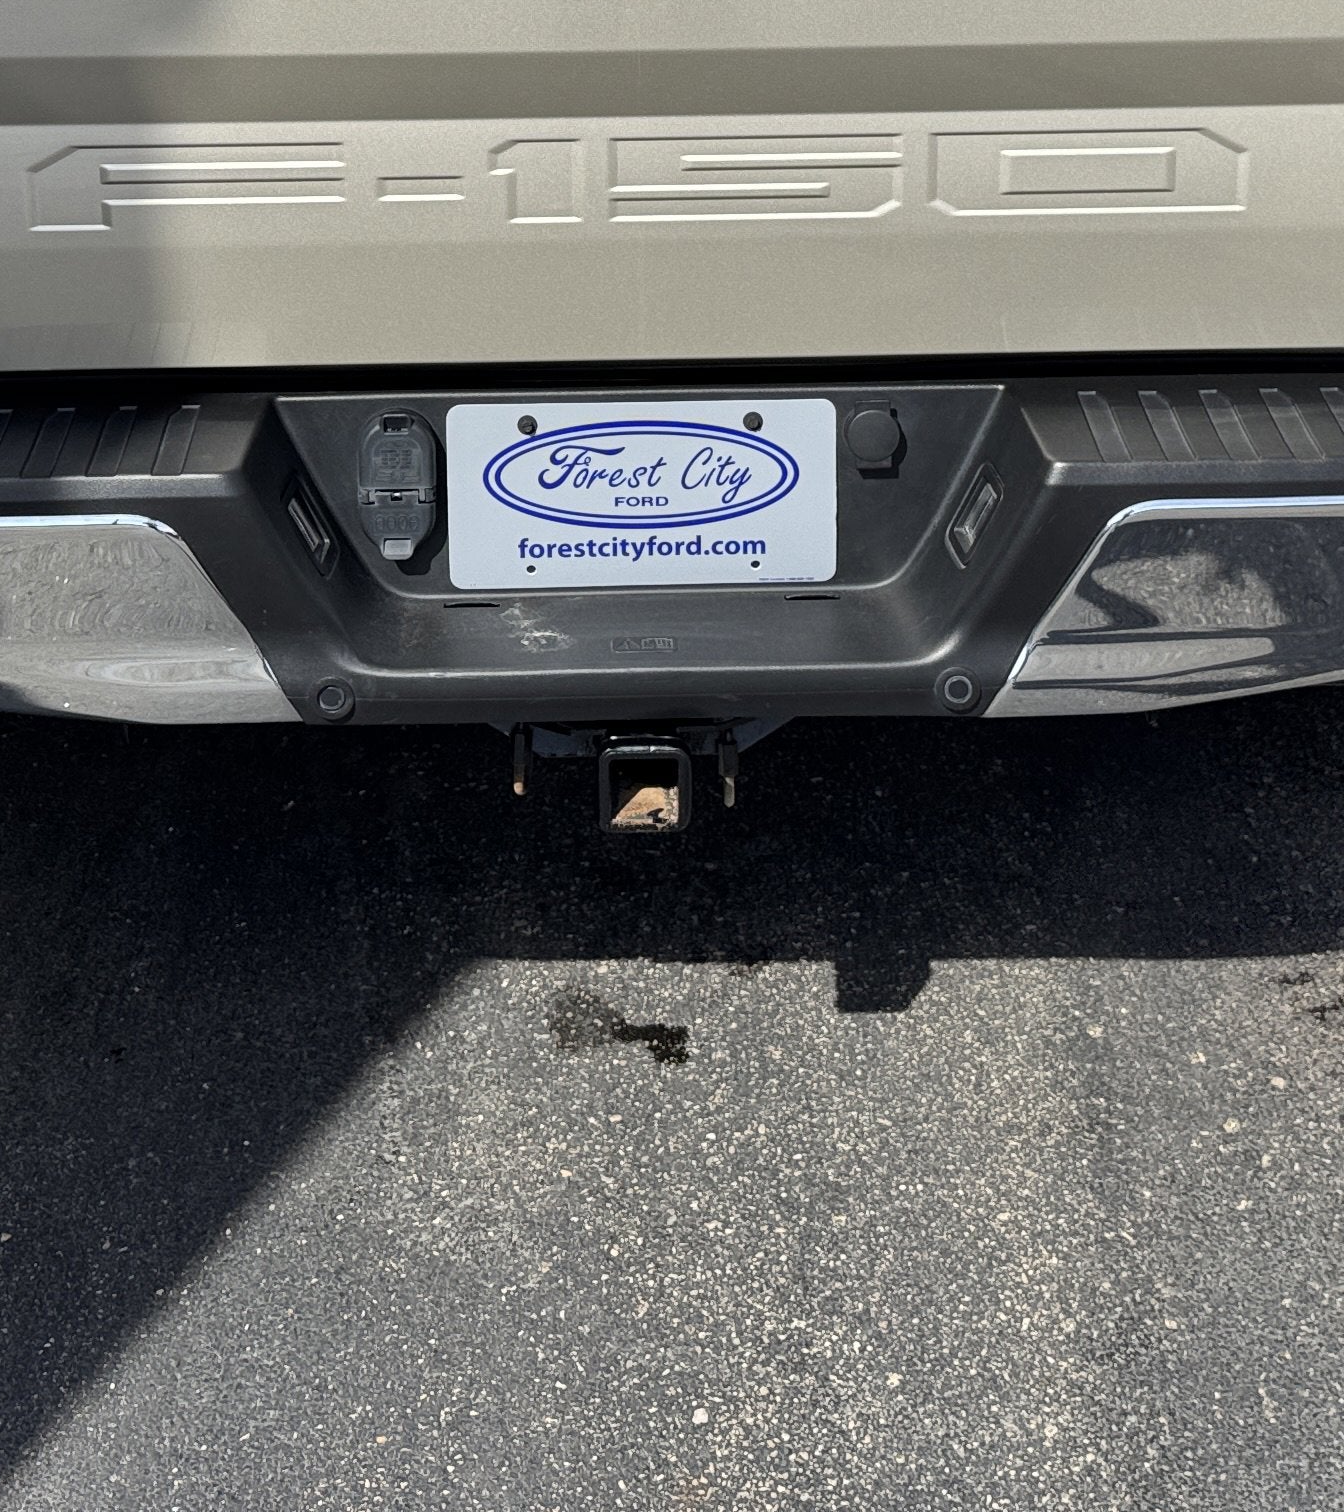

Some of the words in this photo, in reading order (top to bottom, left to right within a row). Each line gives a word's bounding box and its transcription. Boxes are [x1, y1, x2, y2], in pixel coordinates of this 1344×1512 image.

[27, 128, 1248, 231] F-150
[538, 445, 668, 489] Forest
[681, 446, 753, 504] City
[614, 496, 669, 507] FORD
[518, 535, 766, 562] forestcityford.com
